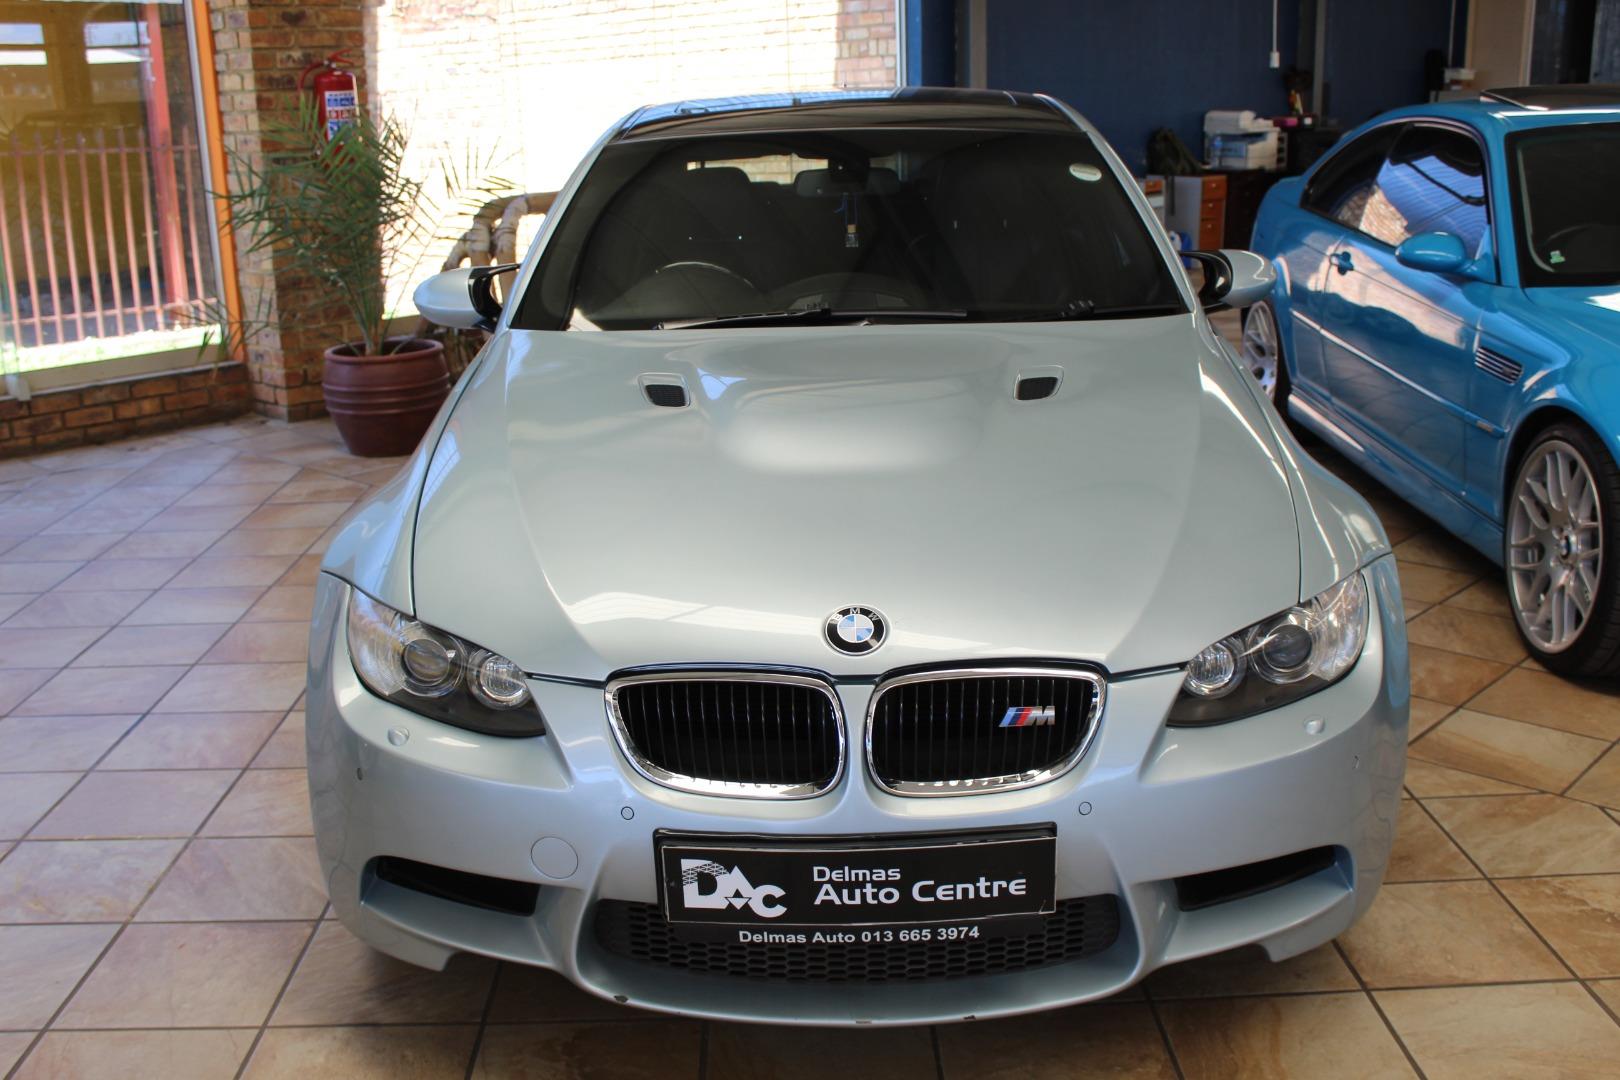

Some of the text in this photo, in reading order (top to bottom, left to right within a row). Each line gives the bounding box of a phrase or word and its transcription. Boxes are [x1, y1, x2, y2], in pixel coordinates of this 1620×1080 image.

[833, 607, 880, 621] BMW
[1021, 705, 1056, 727] M
[812, 866, 901, 882] Delmas
[813, 876, 1027, 905] Auto Centre
[738, 926, 980, 943] Delmas Auto 013 665 3974
